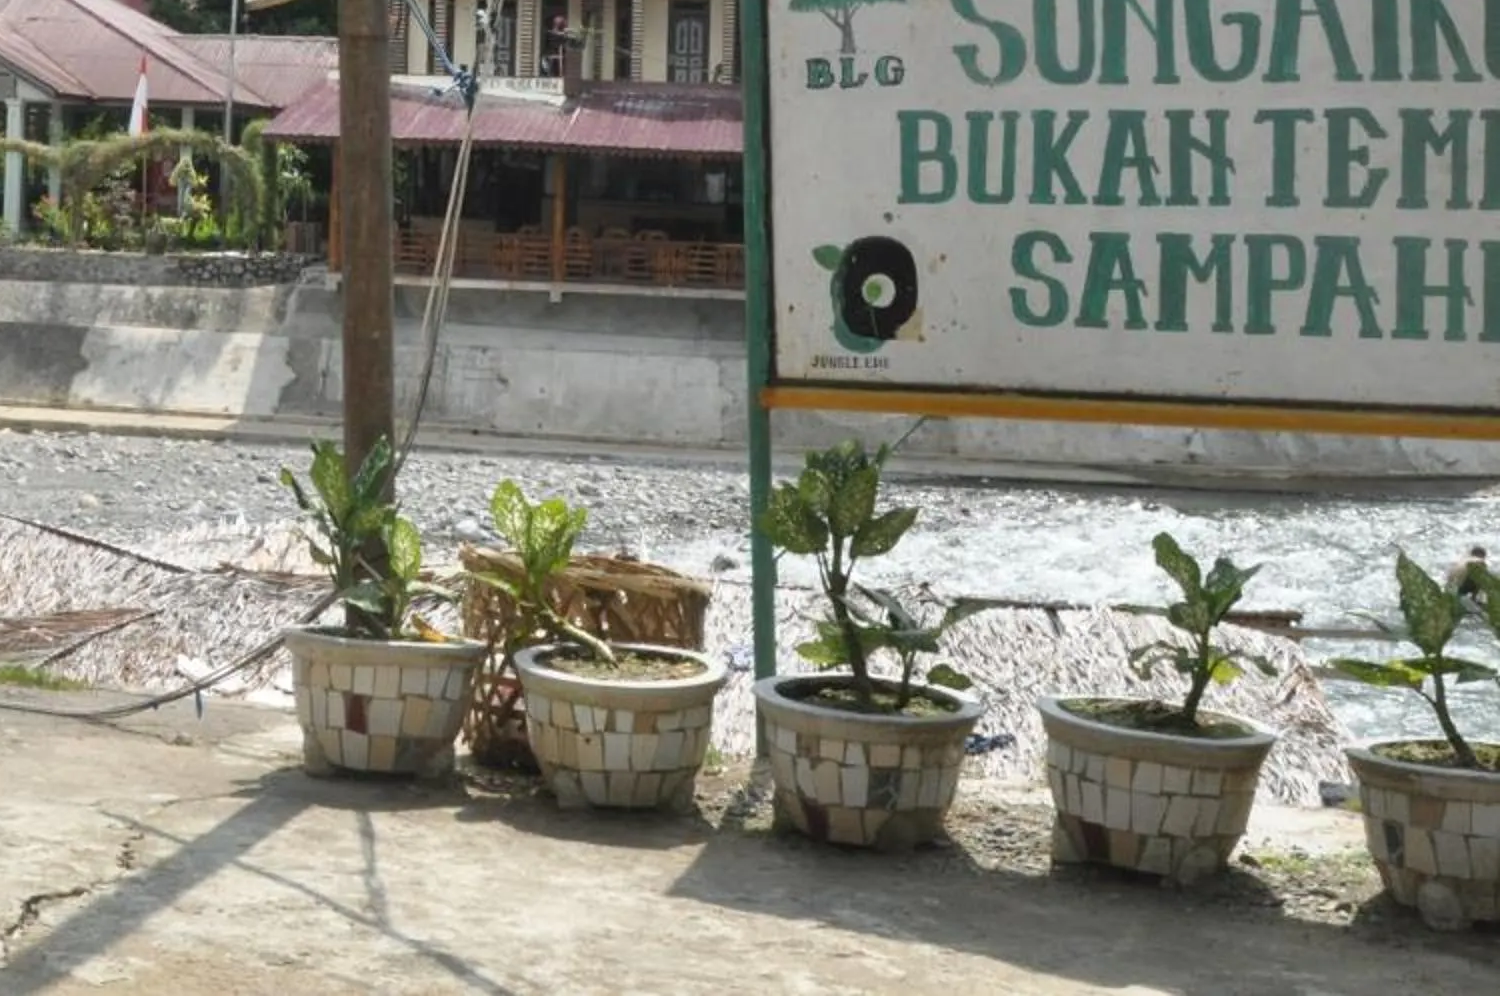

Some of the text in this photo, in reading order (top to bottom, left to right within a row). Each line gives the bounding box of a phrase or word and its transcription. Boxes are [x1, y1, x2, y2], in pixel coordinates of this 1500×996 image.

[805, 55, 905, 90] BLG
[896, 108, 1236, 207] BUKAN
[1007, 230, 1500, 343] SAMPAH
